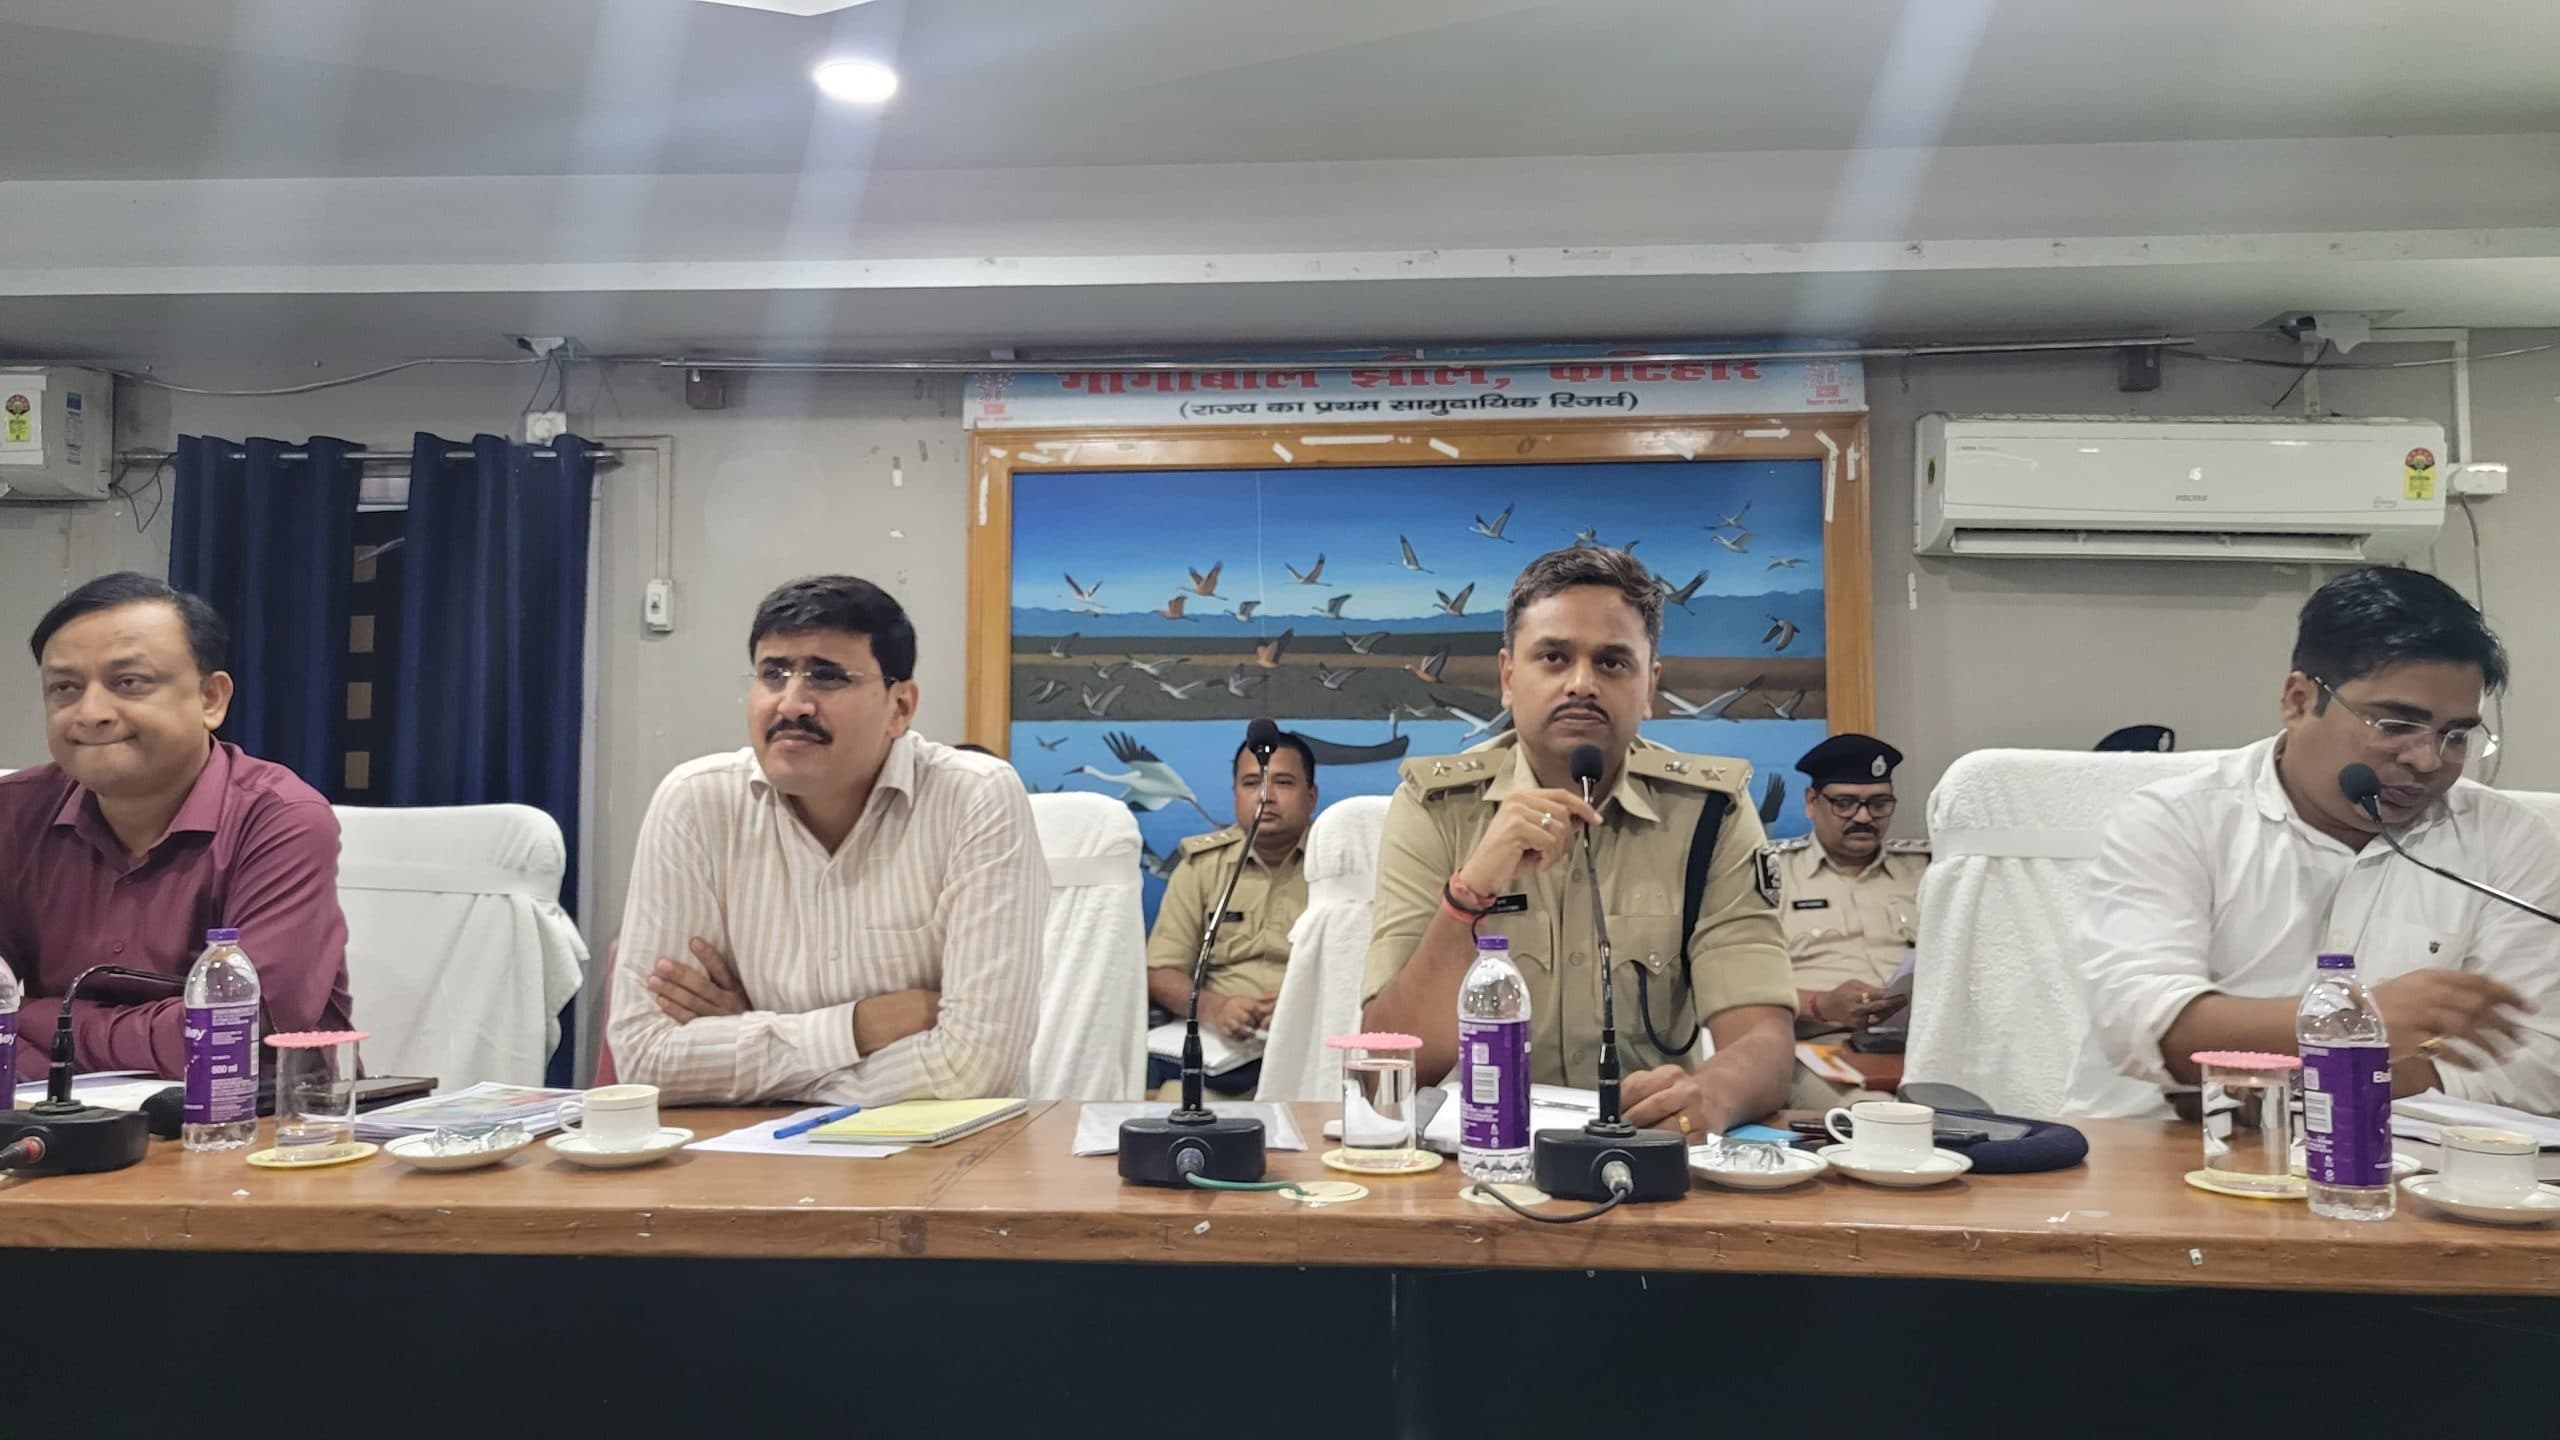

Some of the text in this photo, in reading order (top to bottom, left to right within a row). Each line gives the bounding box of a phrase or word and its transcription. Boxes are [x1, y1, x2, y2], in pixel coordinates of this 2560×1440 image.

[1266, 400, 1305, 414] का
[1313, 399, 1379, 415] प्रथम
[1389, 393, 1538, 416] सामुदायिक
